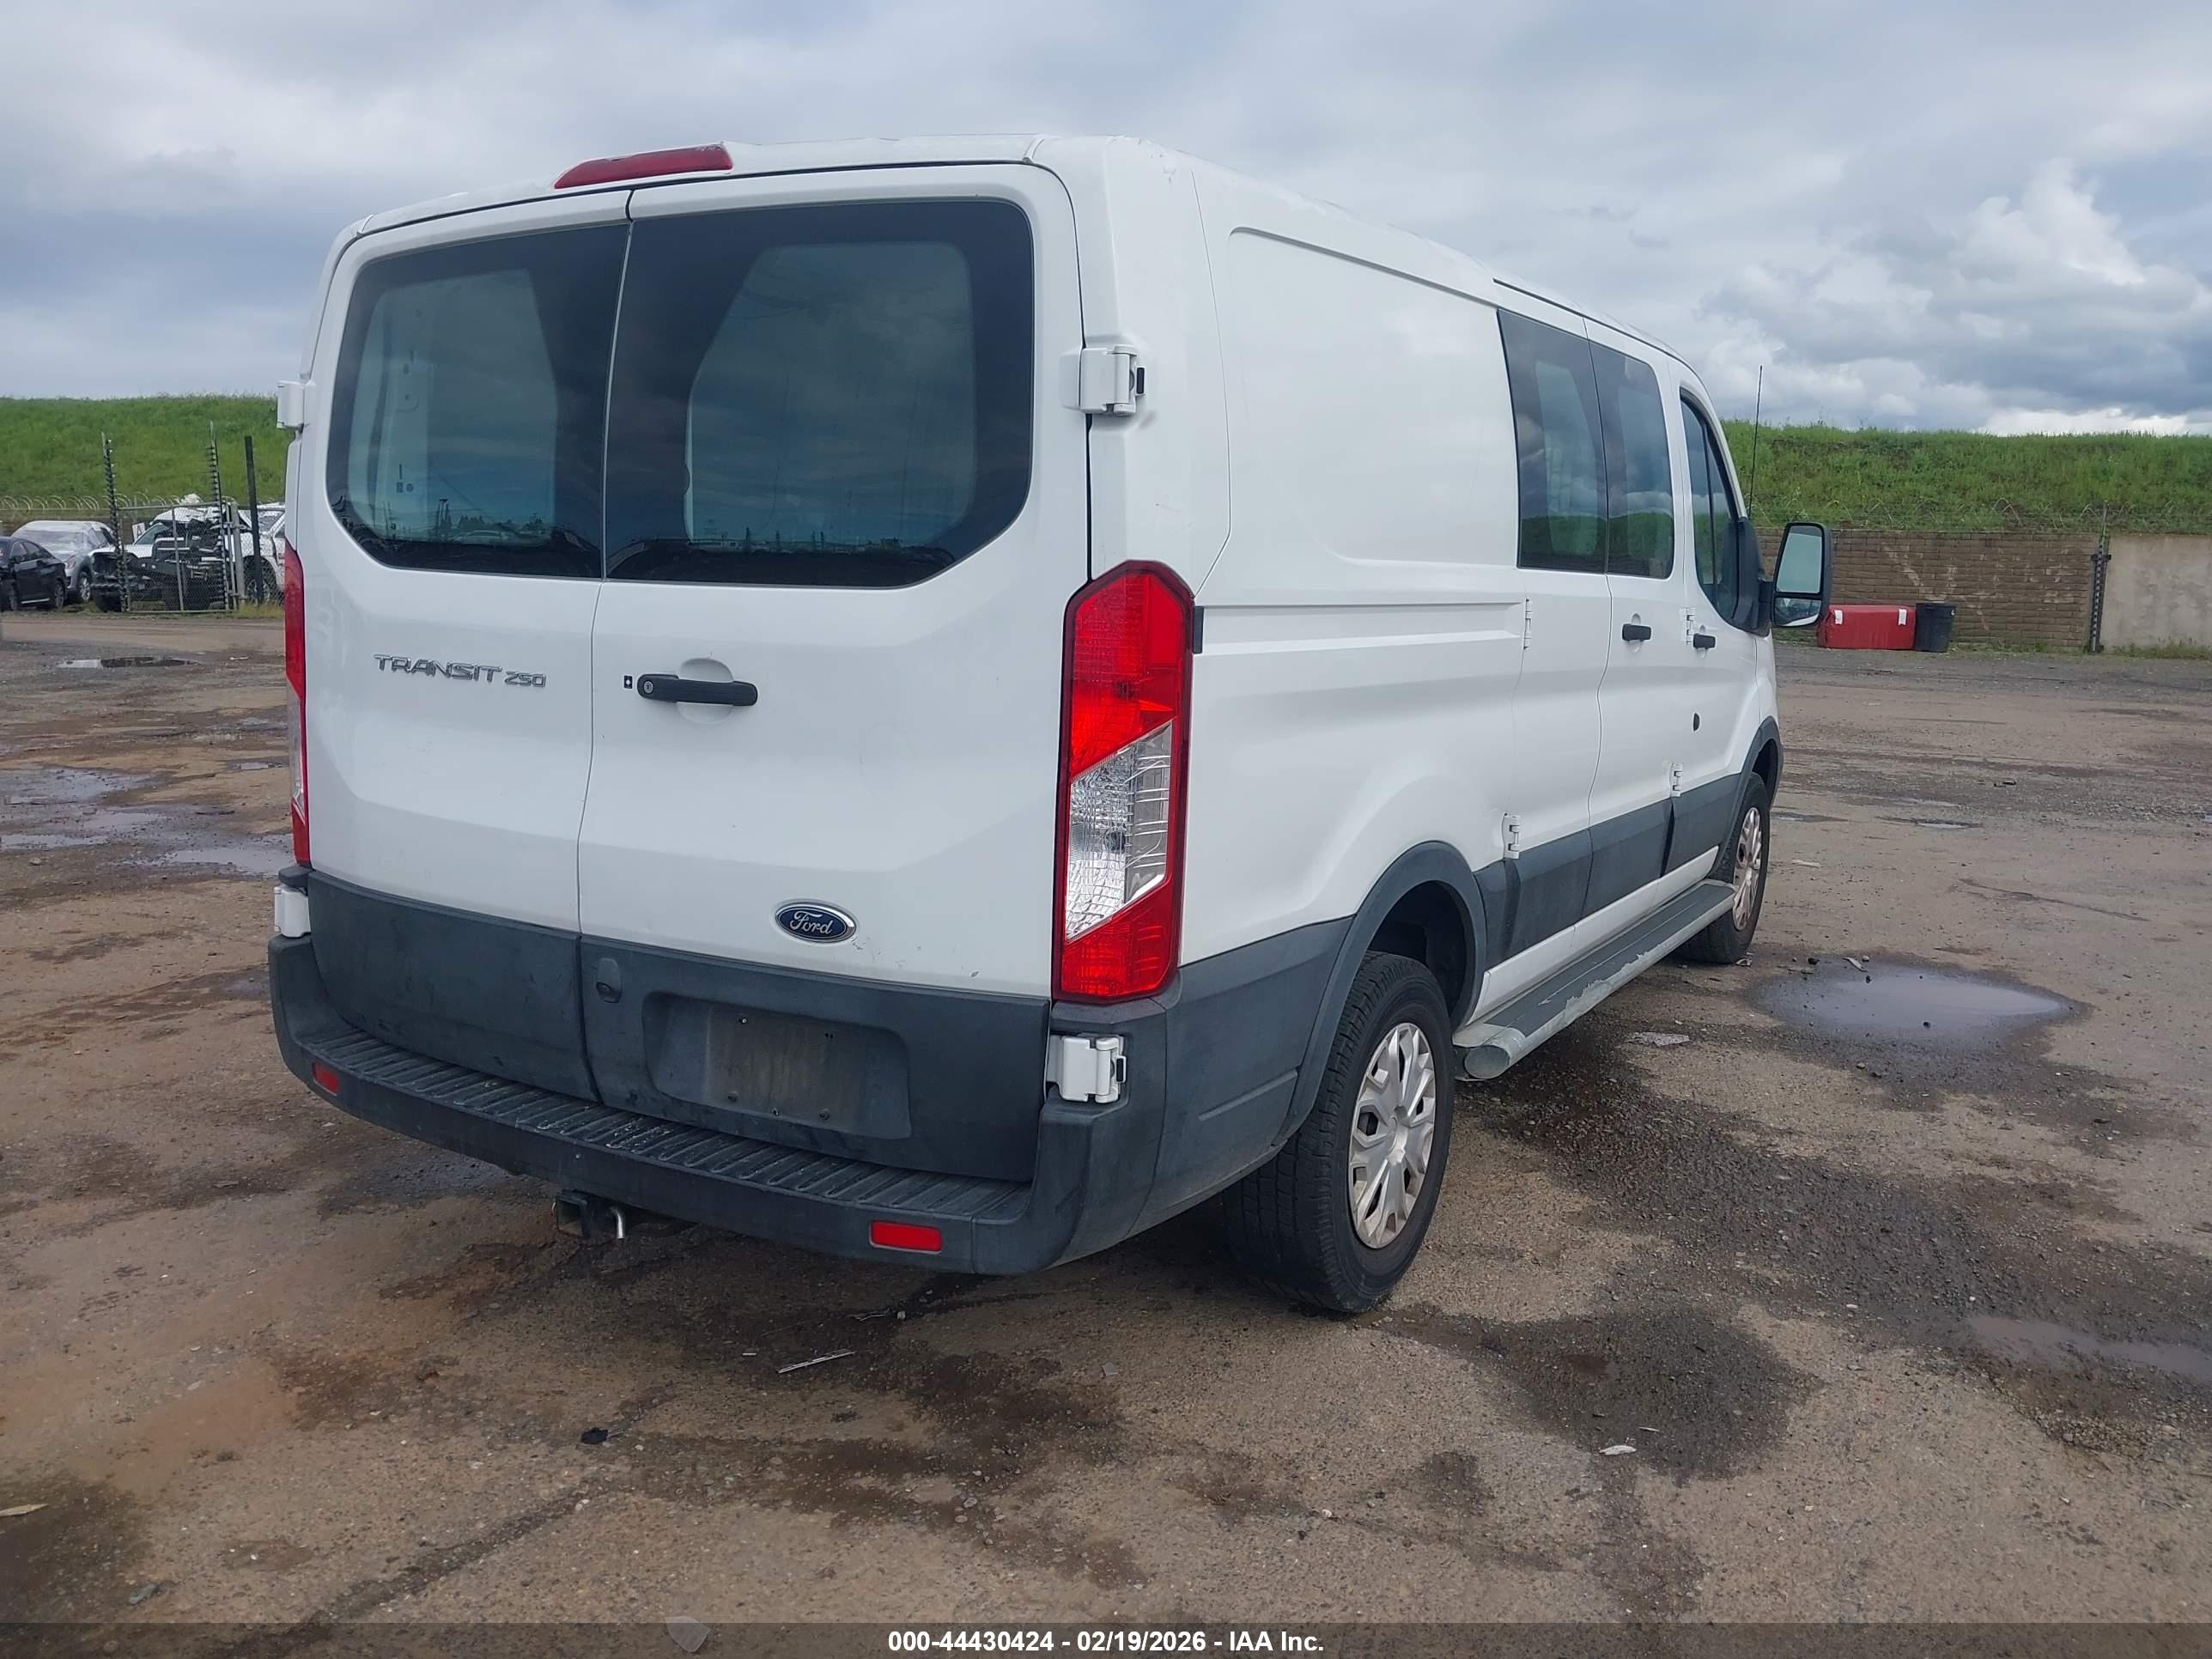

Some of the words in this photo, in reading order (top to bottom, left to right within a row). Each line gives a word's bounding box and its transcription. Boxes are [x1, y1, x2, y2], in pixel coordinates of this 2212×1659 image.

[373, 653, 503, 684] TRANSIT
[504, 670, 547, 688] 250
[789, 910, 834, 934] Ford
